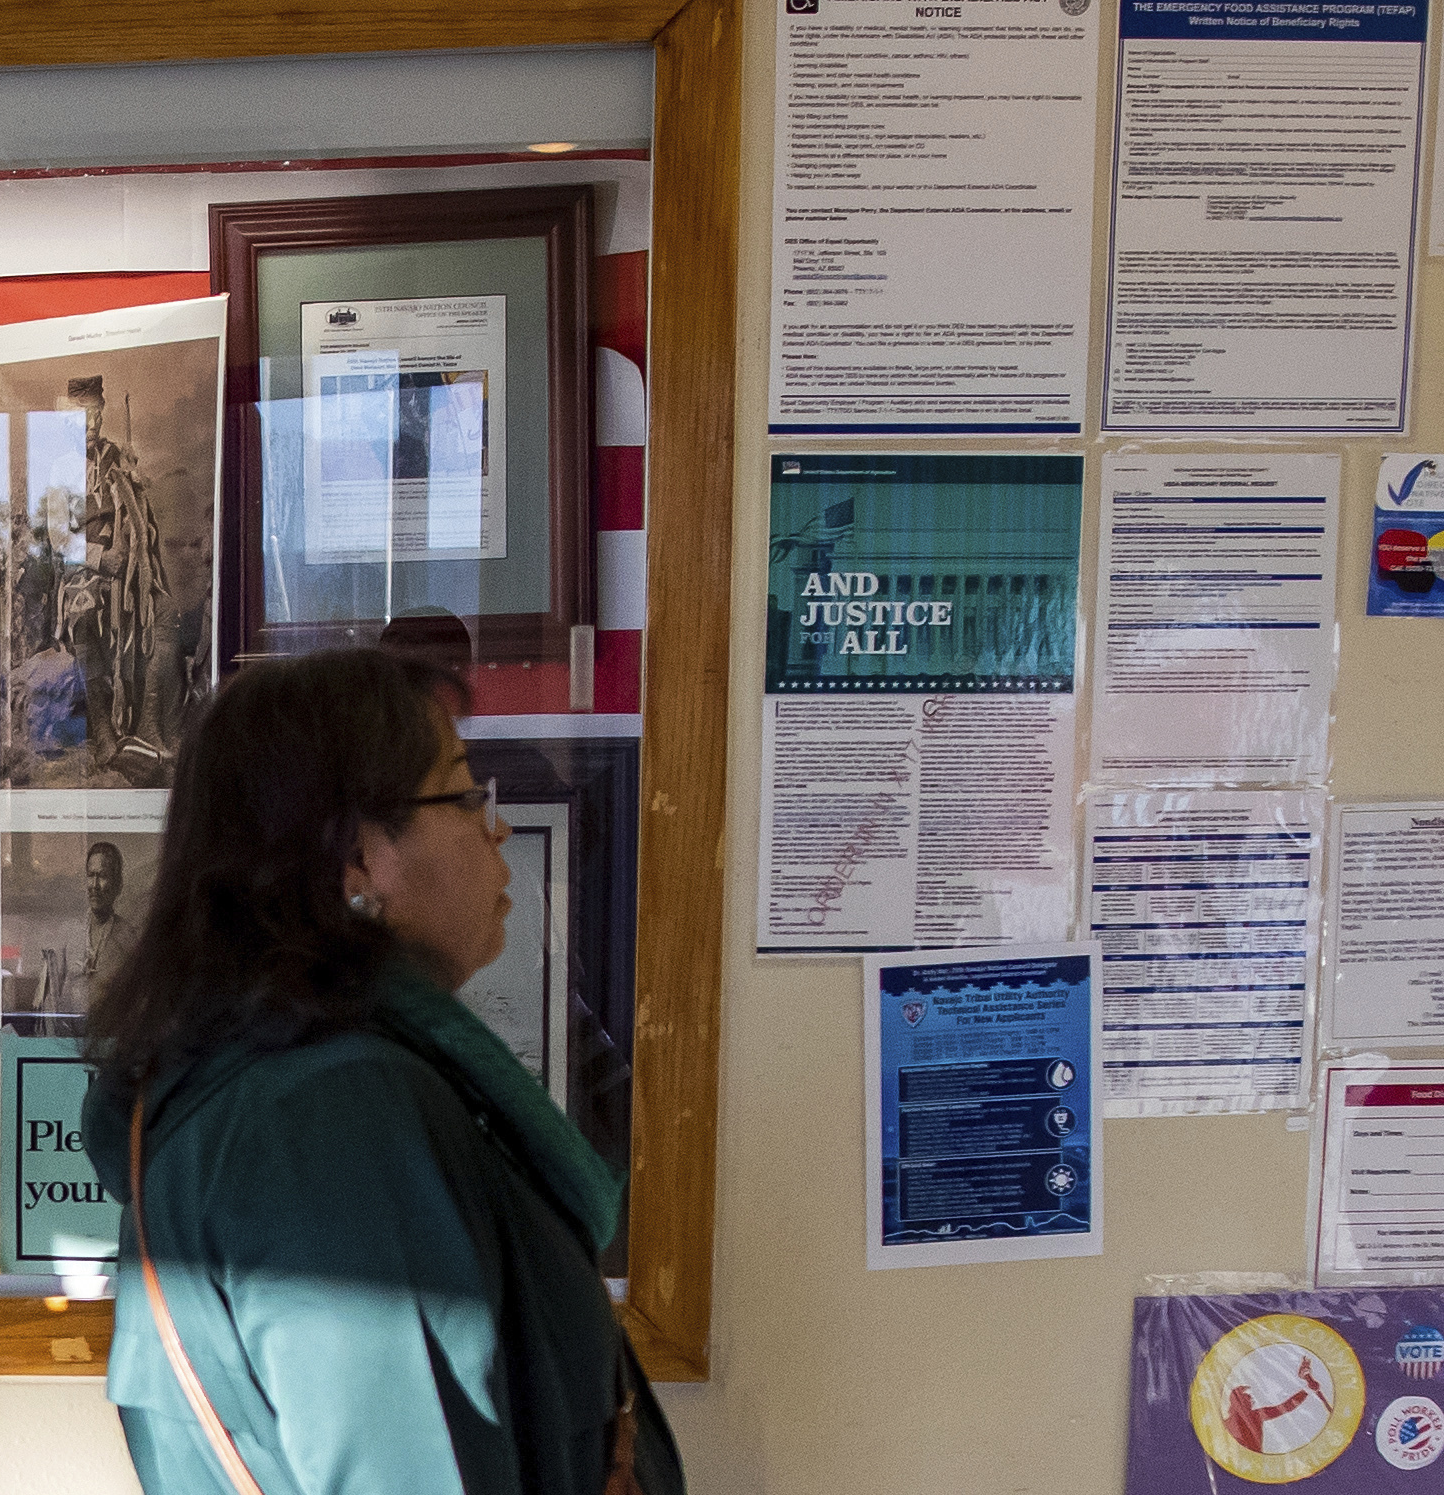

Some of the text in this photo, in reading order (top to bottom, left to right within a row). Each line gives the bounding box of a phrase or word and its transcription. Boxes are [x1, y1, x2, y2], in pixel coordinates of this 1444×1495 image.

[916, 6, 962, 18] NOTICE
[1134, 2, 1416, 17] THE EMERGENCY FOOD ASSISTANCE PROGRAM (TEFAP)
[1189, 16, 1360, 28] Written Notice of Beneficiary Rights
[800, 572, 879, 596] AND
[800, 601, 952, 626] JUSTICE
[800, 630, 908, 655] FOR ALL
[933, 990, 1069, 1005] Navajo Tribal Utility Authority
[938, 1000, 1065, 1015] Technical Assistance Series
[1399, 1345, 1442, 1358] VOTE
[1388, 1405, 1442, 1460] POLL WORKER PRIDE
